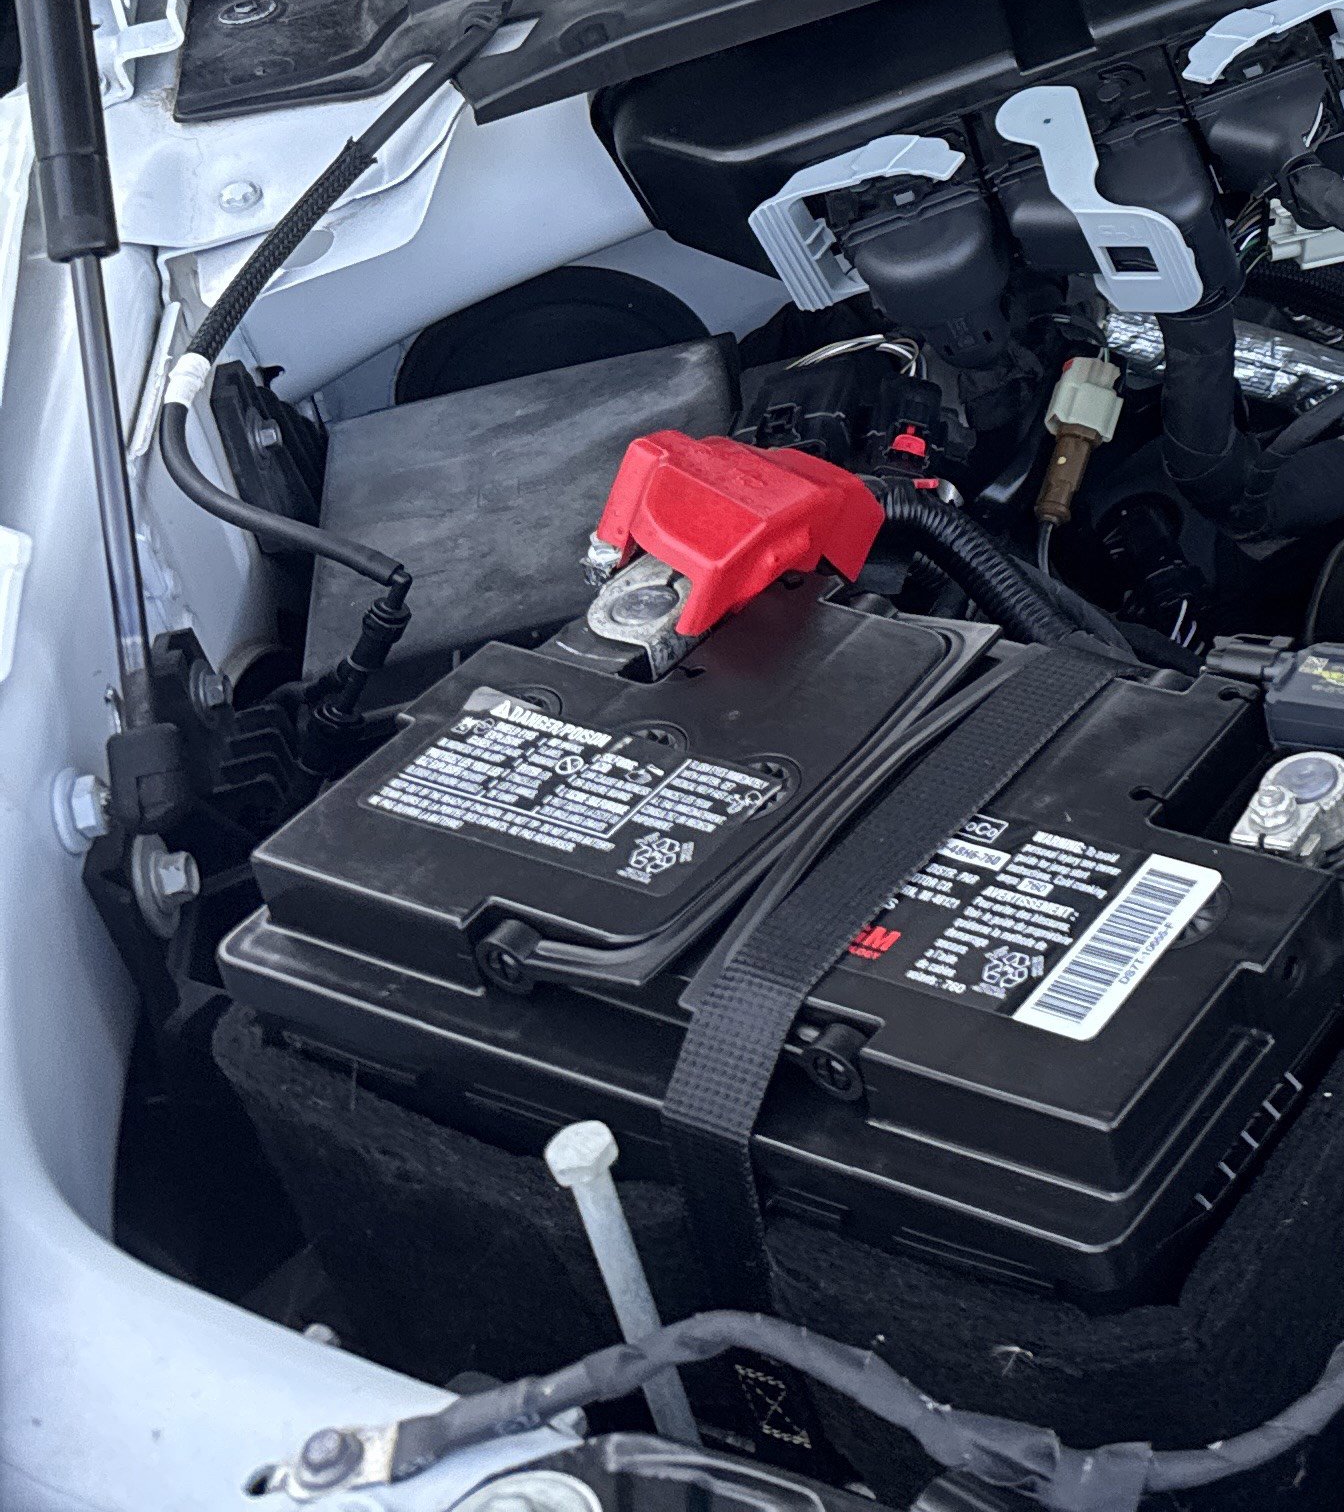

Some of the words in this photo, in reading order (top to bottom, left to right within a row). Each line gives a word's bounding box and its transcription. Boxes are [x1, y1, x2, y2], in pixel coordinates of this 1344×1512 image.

[503, 705, 612, 748] DANGER/POISON
[965, 822, 1003, 839] oCo
[939, 842, 1003, 866] -48H6-760
[910, 873, 939, 888] OTOR
